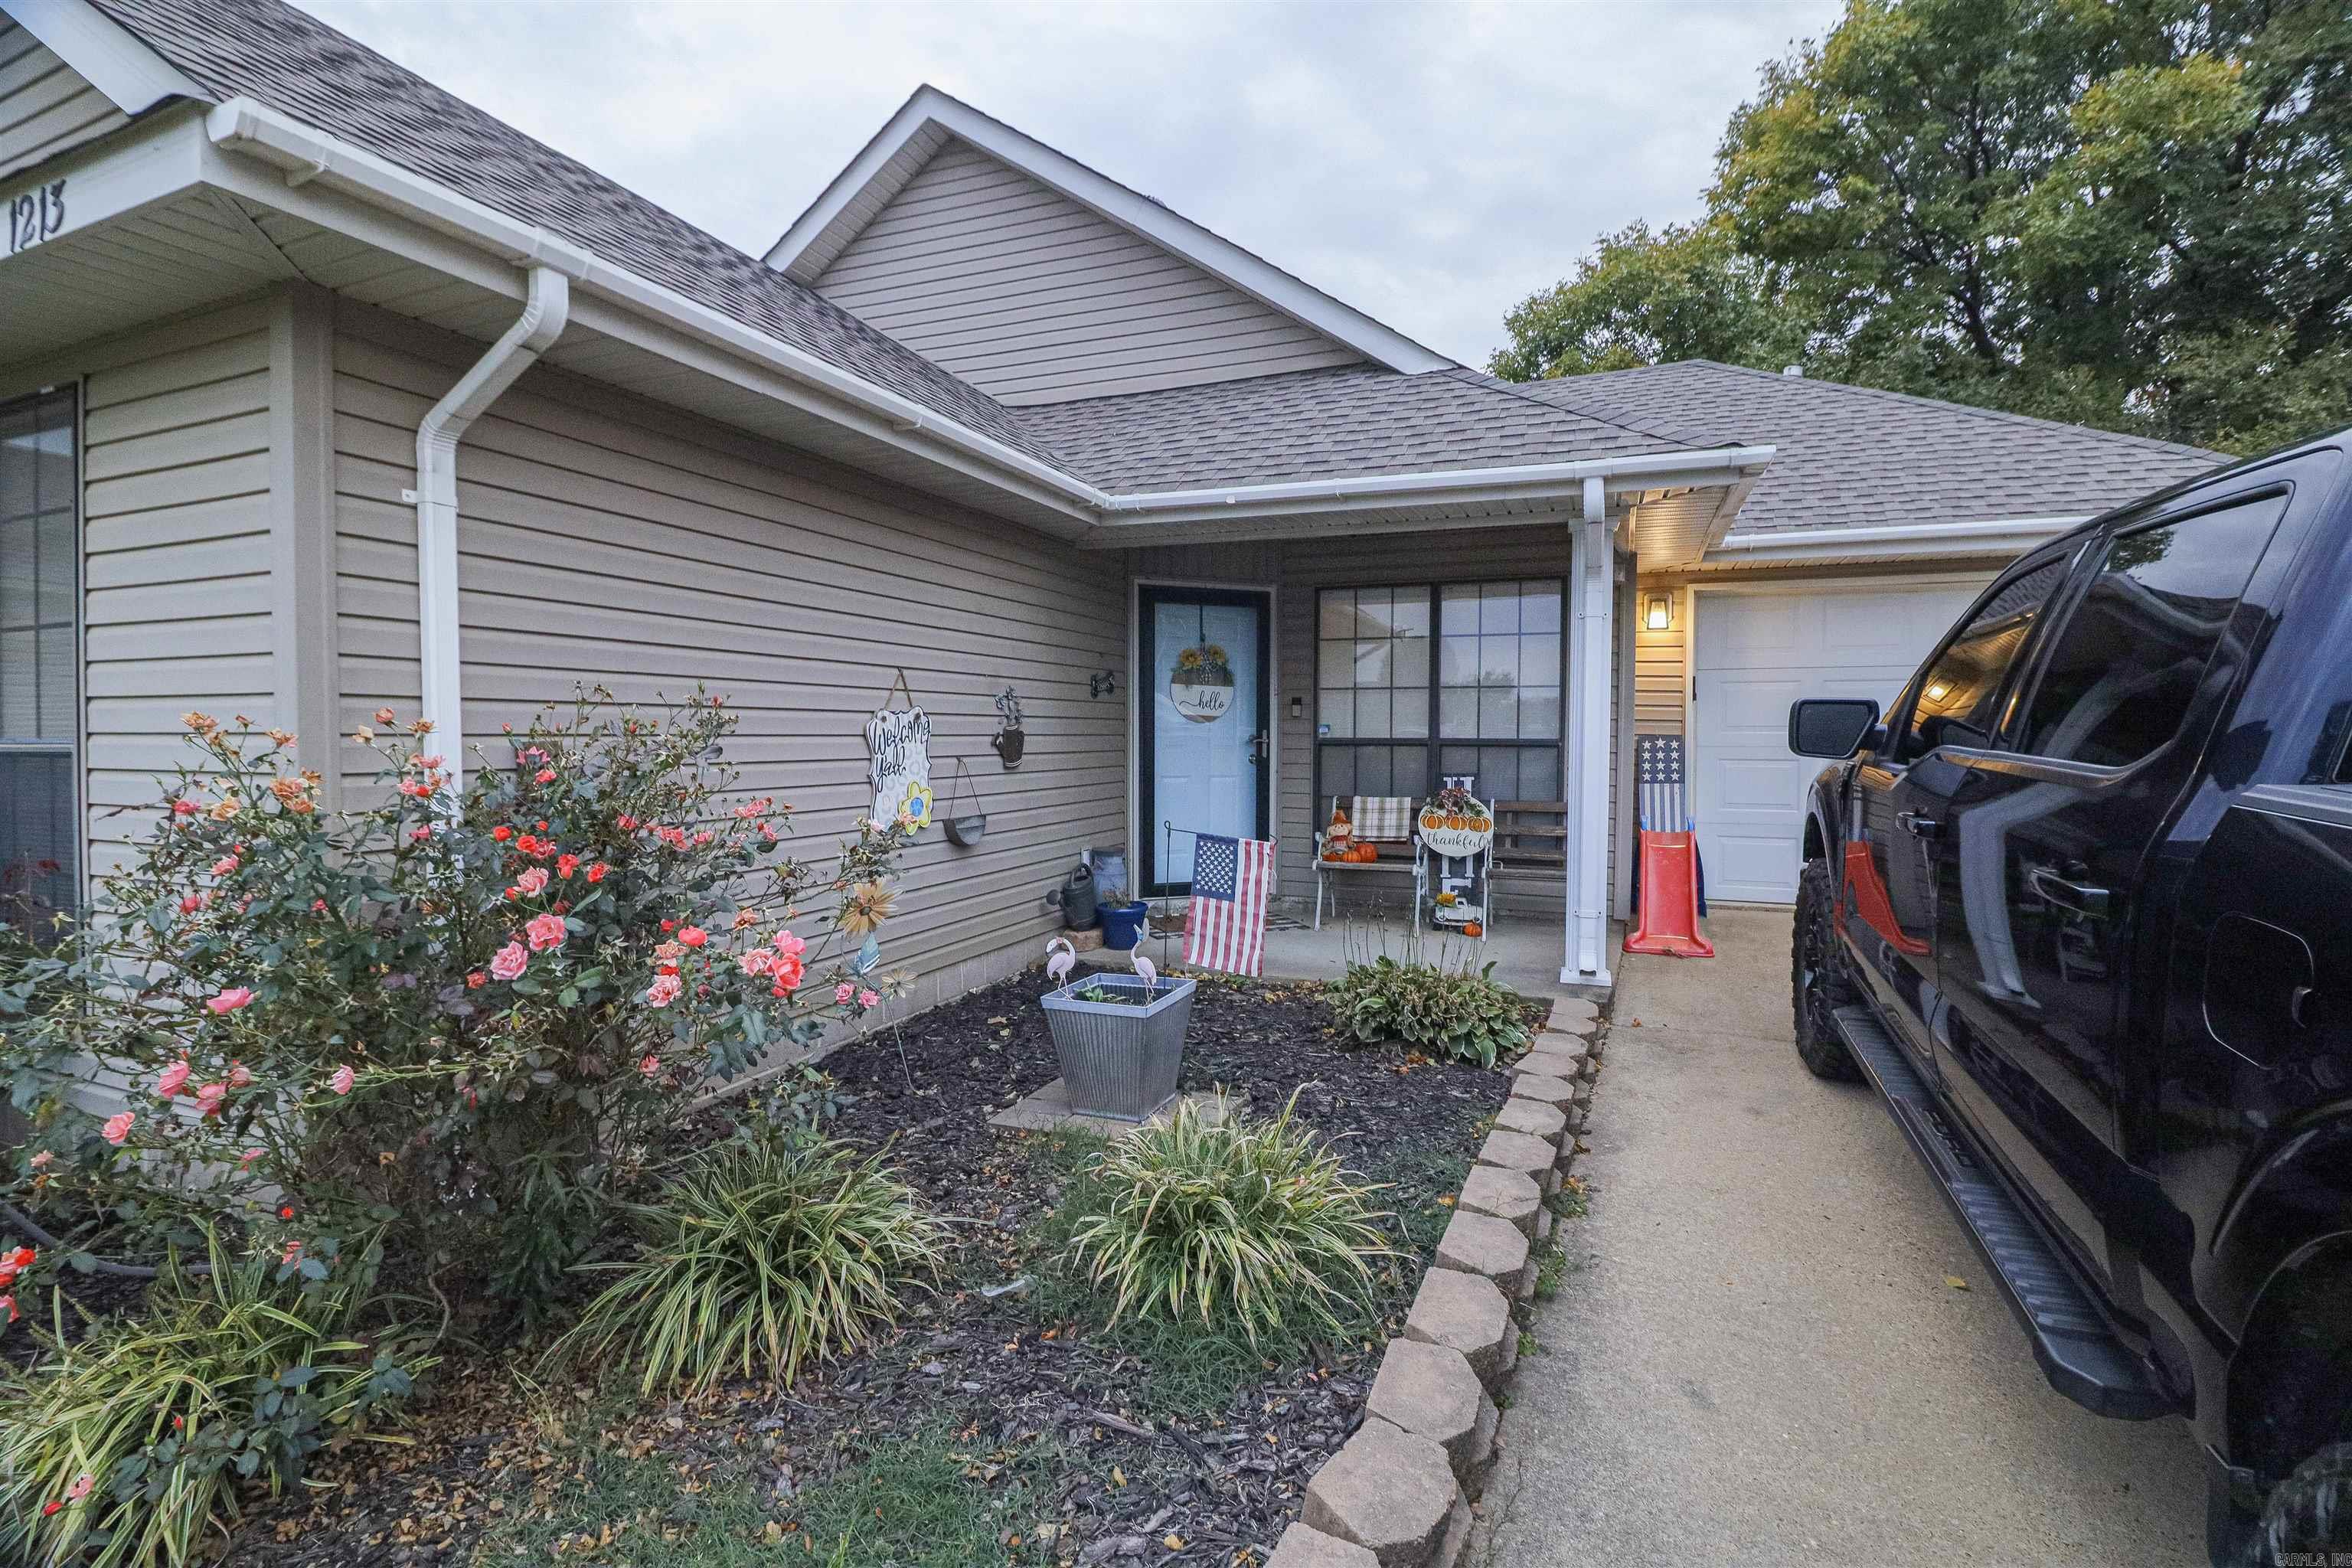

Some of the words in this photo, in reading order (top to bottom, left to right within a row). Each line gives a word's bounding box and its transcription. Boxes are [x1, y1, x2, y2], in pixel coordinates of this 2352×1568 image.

[10, 178, 67, 253] 1213
[1198, 691, 1224, 710] hello
[873, 716, 930, 756] Welcome
[1427, 832, 1488, 850] thankful
